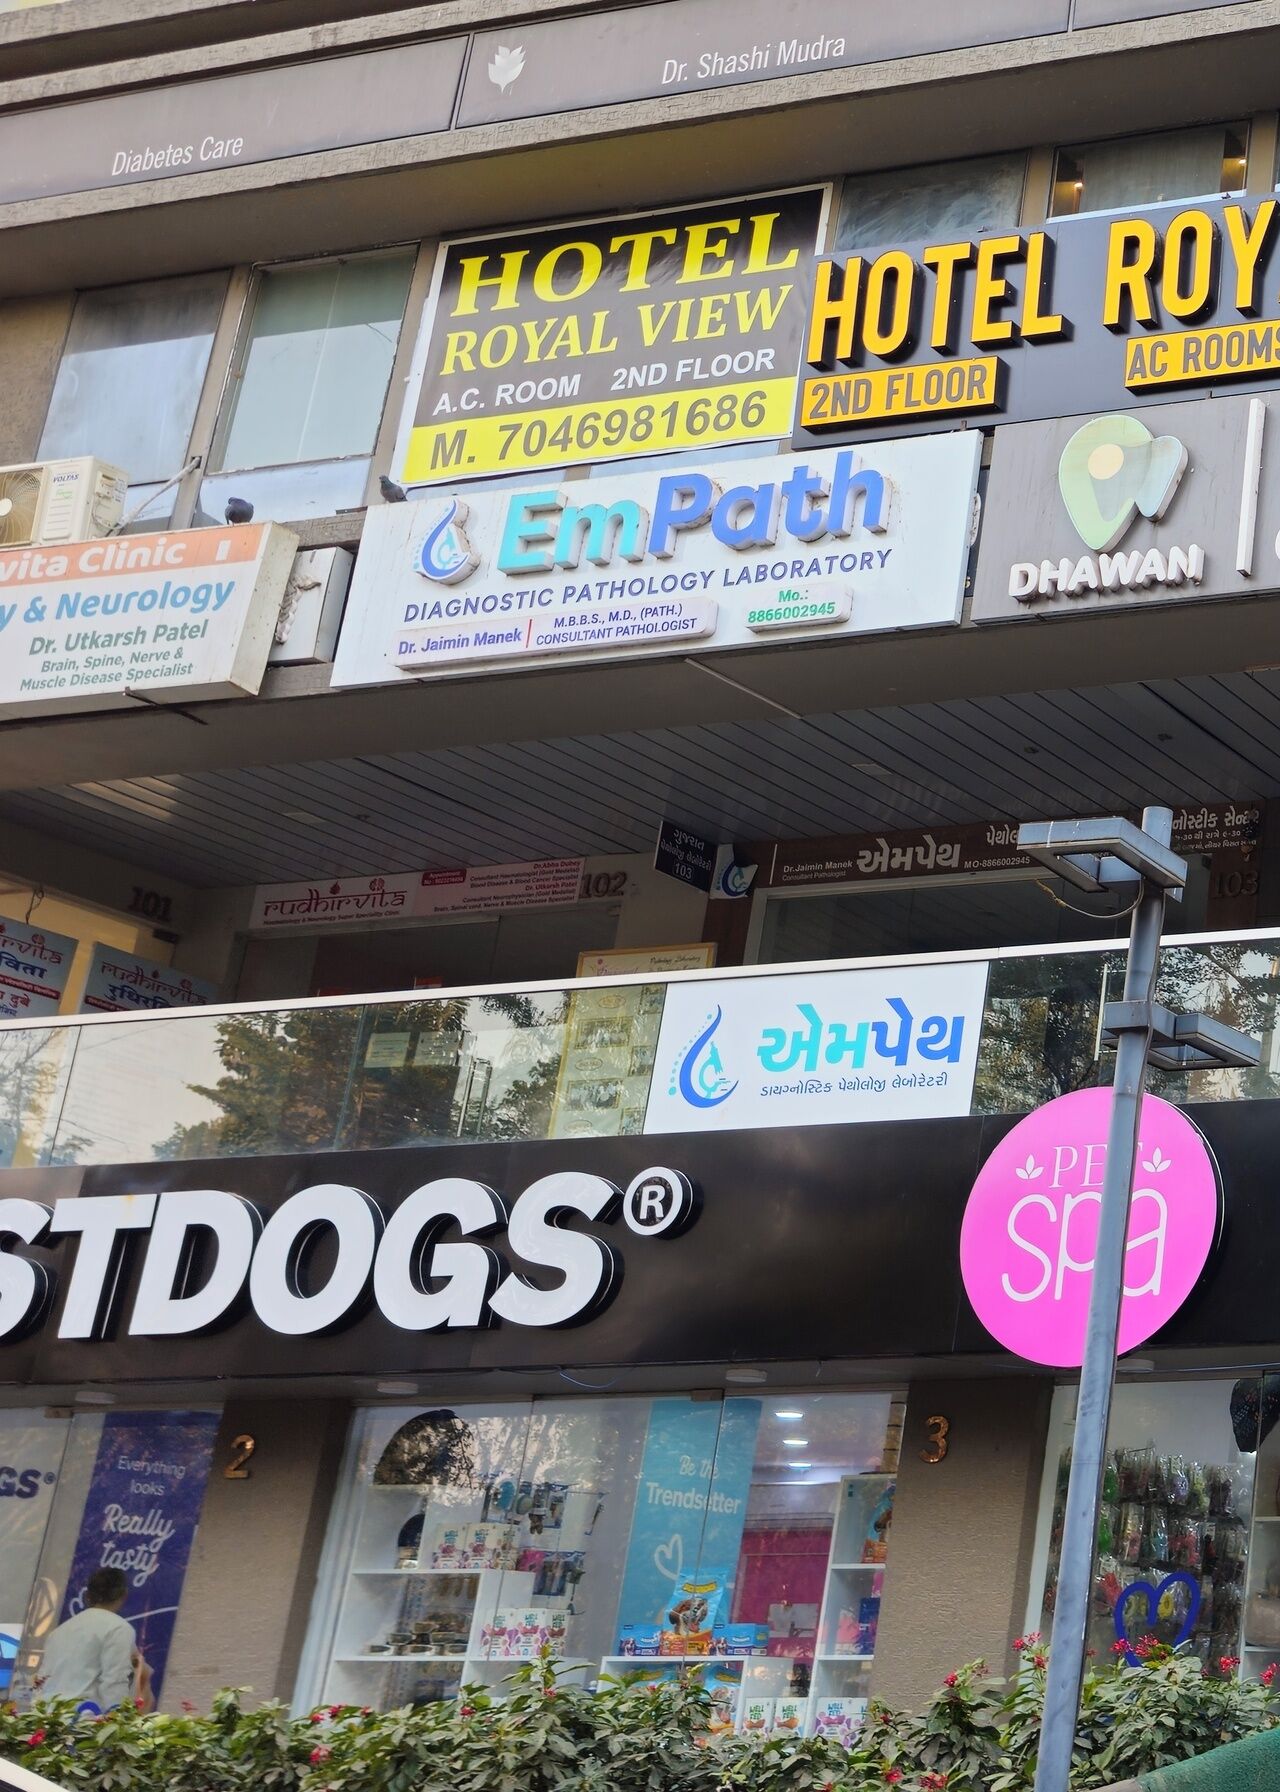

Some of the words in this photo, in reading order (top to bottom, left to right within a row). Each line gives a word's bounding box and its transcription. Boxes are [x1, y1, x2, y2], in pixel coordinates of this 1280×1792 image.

[662, 58, 689, 85] Dr.
[696, 44, 770, 79] Shashi
[776, 34, 846, 66] Mudra
[111, 143, 193, 176] Diabetes
[199, 136, 243, 161] Care
[450, 212, 799, 318] HOTEL
[806, 231, 1066, 367] HOTEL
[440, 310, 618, 376] ROYAL
[637, 284, 793, 347] VIEW
[1127, 342, 1169, 381] AC
[432, 387, 485, 416] A.C.
[495, 373, 581, 406] ROOM
[610, 362, 668, 391] 2ND
[675, 348, 776, 383] FLOOR
[810, 378, 876, 420] 2ND
[886, 363, 988, 409] FLOOR
[430, 429, 476, 470] M.
[498, 390, 767, 461] 7046981686
[498, 450, 890, 577] EmPath
[78, 537, 187, 572] Clinic
[1008, 544, 1204, 601] DHAWAN
[23, 596, 47, 623] &
[55, 581, 235, 620] Neurology
[404, 588, 553, 622] DIAGNOSTIC
[562, 570, 715, 604] PATHOLOGY
[723, 548, 892, 586] LABORATORY
[777, 589, 809, 604] Mo.:
[536, 627, 613, 646] CONSULTANT
[615, 617, 697, 639] PATHOLOGIST
[554, 613, 605, 629] M.B.B.S.,
[608, 609, 637, 622] M.D.,
[640, 603, 683, 621] (PATH.)
[748, 601, 836, 625] 8866002945
[29, 636, 57, 656] Dr.
[65, 626, 147, 651] Utkarsh
[153, 619, 209, 643] Patel
[398, 640, 417, 655] Dr.
[421, 634, 469, 653] Jaimin
[473, 627, 522, 646] Manek
[20, 674, 66, 691] Muscle
[70, 670, 122, 686] Disease
[126, 662, 194, 684] Specialist
[41, 657, 80, 674] Brain,
[83, 654, 126, 671] Spine,
[130, 651, 170, 664] Nerve
[174, 647, 184, 660] &
[673, 829, 705, 850] ગુજરાત
[856, 834, 960, 873] એમપેથ
[675, 862, 692, 879] 103
[825, 860, 853, 869] Manek
[131, 886, 172, 921] 101
[264, 888, 407, 916] rudhirvita
[582, 872, 628, 898] 102
[757, 997, 965, 1072] એમપેથ
[838, 1076, 886, 1092] પેથોલોજી
[892, 1071, 948, 1088] લેબોરેટરી
[1049, 1142, 1143, 1189] PE
[223, 1434, 256, 1479] 2
[920, 1415, 950, 1464] 3
[117, 1455, 186, 1480] Everything
[679, 1455, 697, 1476] Be
[700, 1459, 720, 1479] the
[130, 1479, 165, 1496] looks
[646, 1482, 742, 1514] Trendsetter
[102, 1503, 176, 1553] Really
[100, 1540, 160, 1588] tasty
